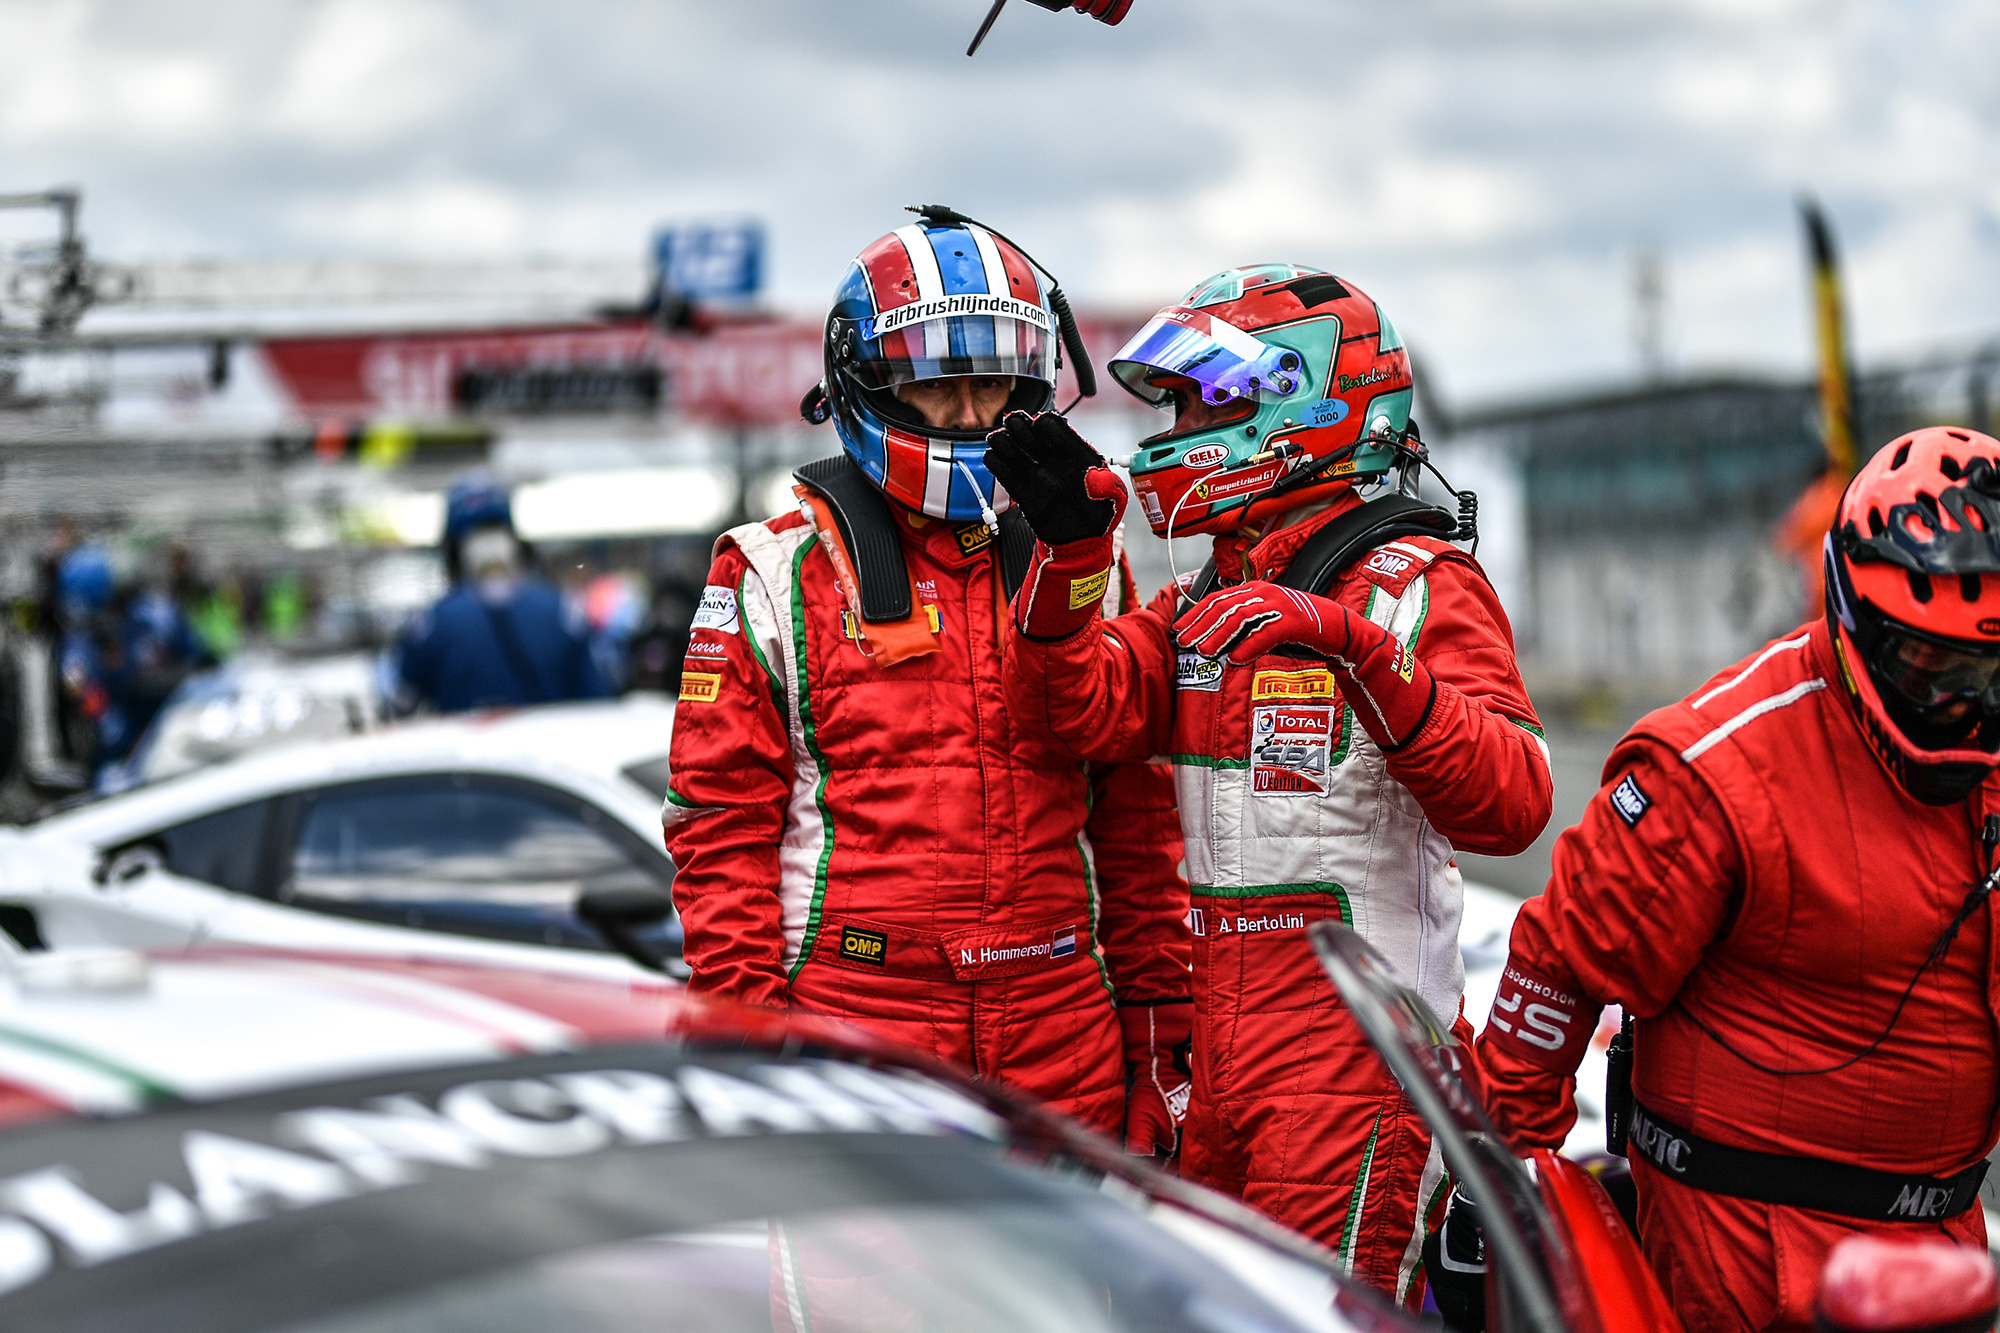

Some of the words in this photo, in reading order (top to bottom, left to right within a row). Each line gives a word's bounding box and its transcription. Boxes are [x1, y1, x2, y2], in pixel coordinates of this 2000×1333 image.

[884, 296, 1047, 329] airbrushlijnden.com
[1338, 365, 1392, 393] Bertolini
[1314, 411, 1339, 424] 1000
[1189, 447, 1223, 464] BELL
[1210, 474, 1262, 493] Competizioni
[1263, 469, 1275, 480] GT
[1369, 553, 1409, 574] OMP
[690, 643, 725, 653] corse
[1258, 674, 1328, 694] PIRELLI
[1276, 714, 1327, 729] TOTAL
[1288, 739, 1327, 747] HOURS
[1260, 746, 1325, 775] SPA
[1268, 777, 1302, 790] EDITION
[1614, 782, 1643, 815] OMP
[1219, 917, 1232, 932] A.
[1237, 913, 1304, 932] Bertolini
[844, 936, 882, 955] OMP
[961, 949, 977, 964] N.
[980, 942, 1050, 963] Hommerson
[1631, 1105, 1692, 1173] MRTC
